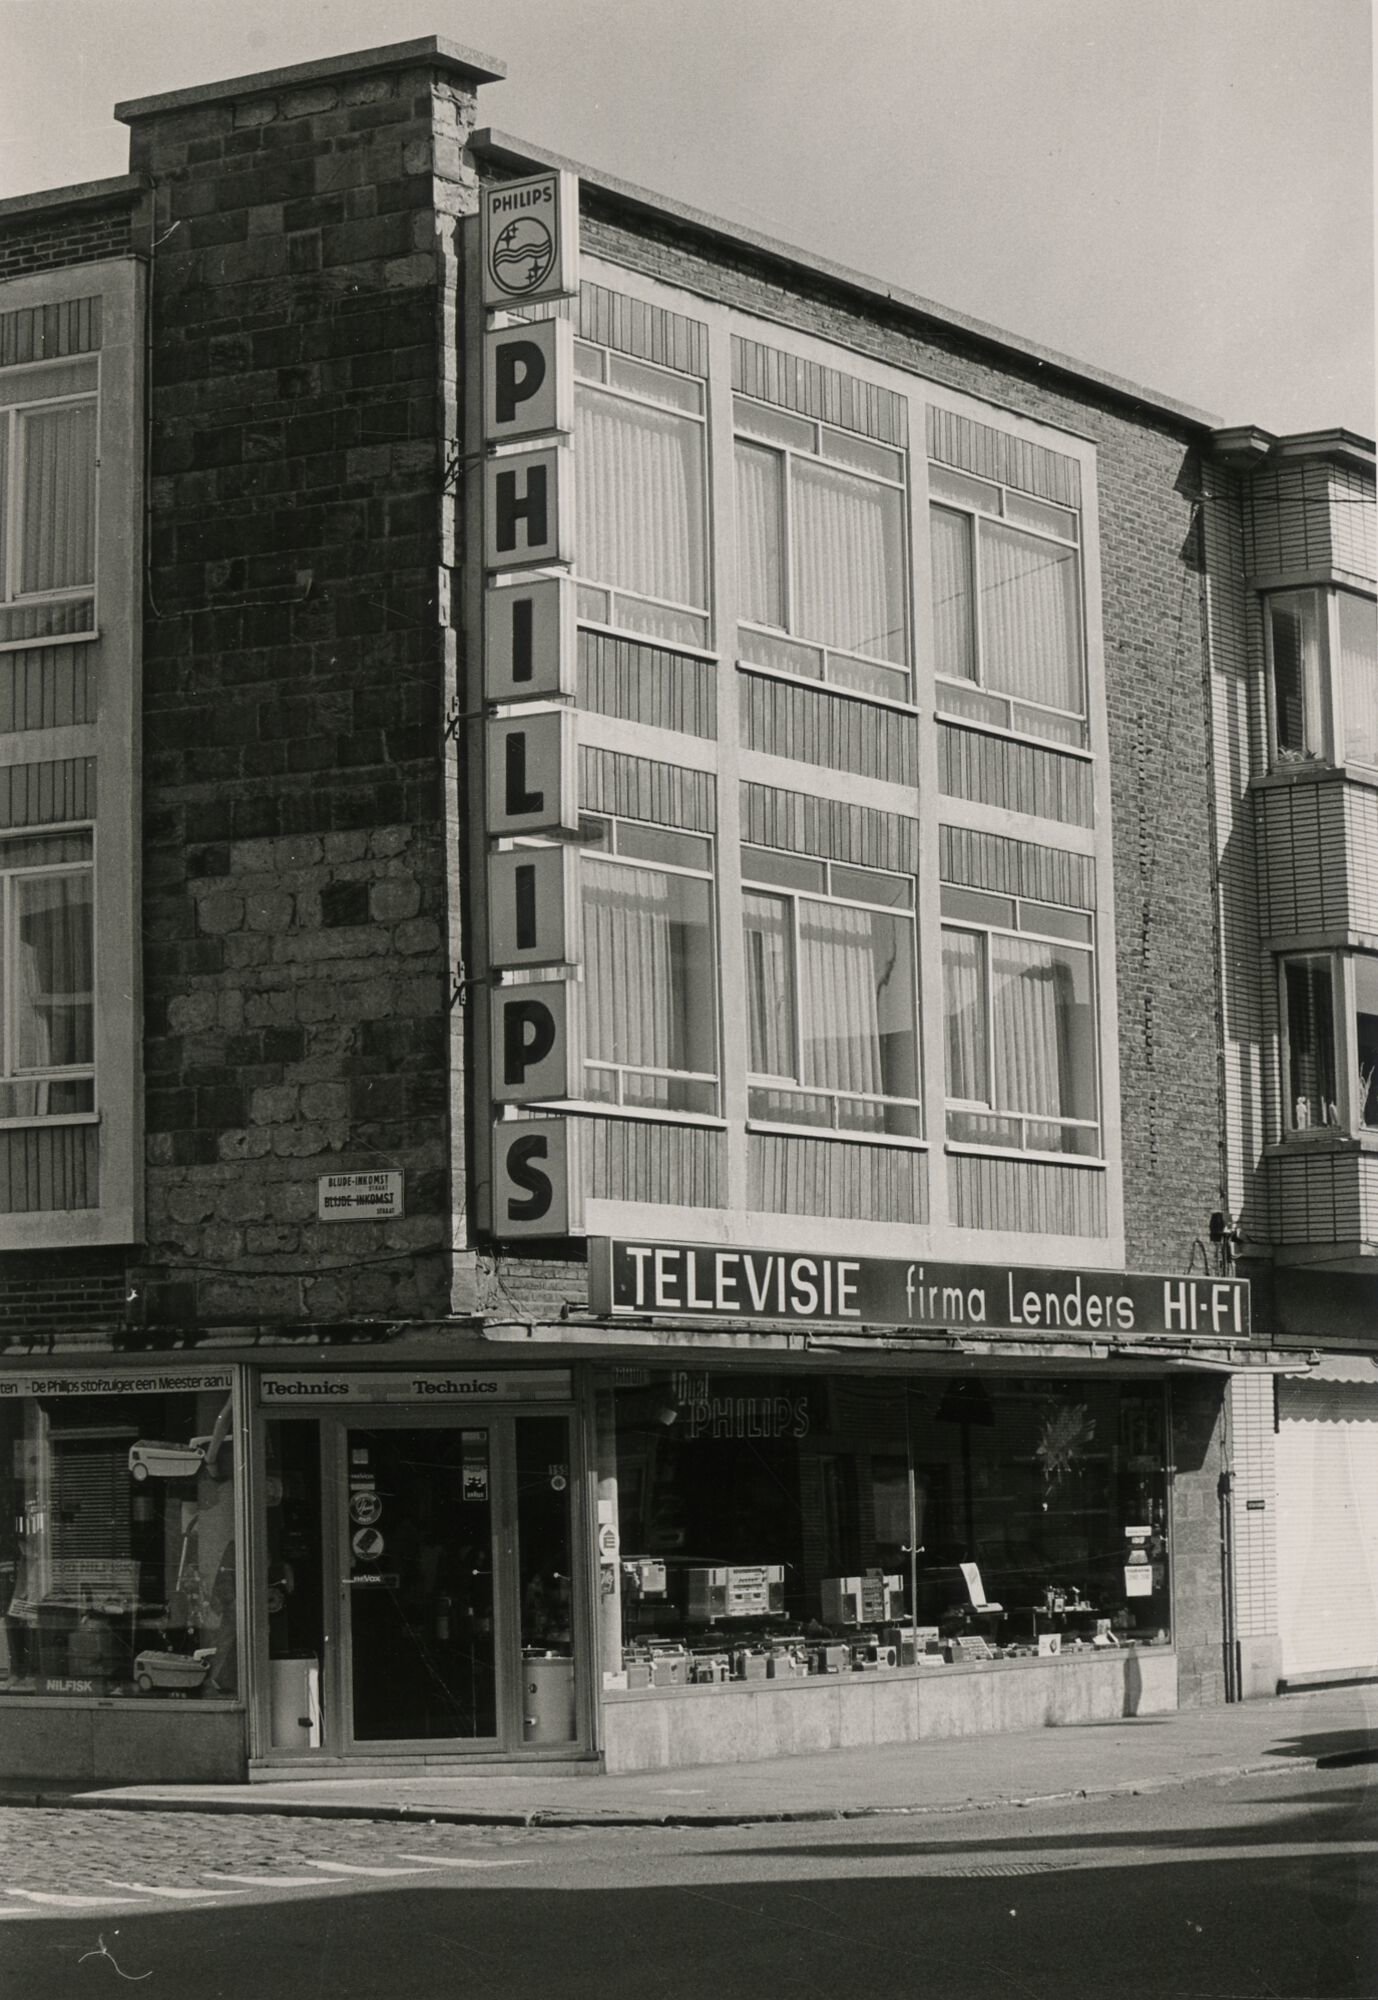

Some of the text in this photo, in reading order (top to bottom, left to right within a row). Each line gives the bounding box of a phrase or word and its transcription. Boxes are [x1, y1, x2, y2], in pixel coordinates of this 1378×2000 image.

[493, 186, 553, 214] PHILIPS
[495, 340, 556, 1221] PHILIPS
[626, 1247, 1242, 1332] TELEVISIE firma Lenders HI-FI
[31, 1380, 47, 1393] De
[48, 1379, 80, 1394] Philips
[135, 1379, 157, 1391] een
[159, 1376, 202, 1390] Meester
[204, 1376, 224, 1388] aan
[263, 1380, 349, 1395] Technics
[412, 1379, 498, 1394] Technics
[689, 1396, 810, 1439] PHILIPS
[46, 1679, 93, 1692] NILFISK
